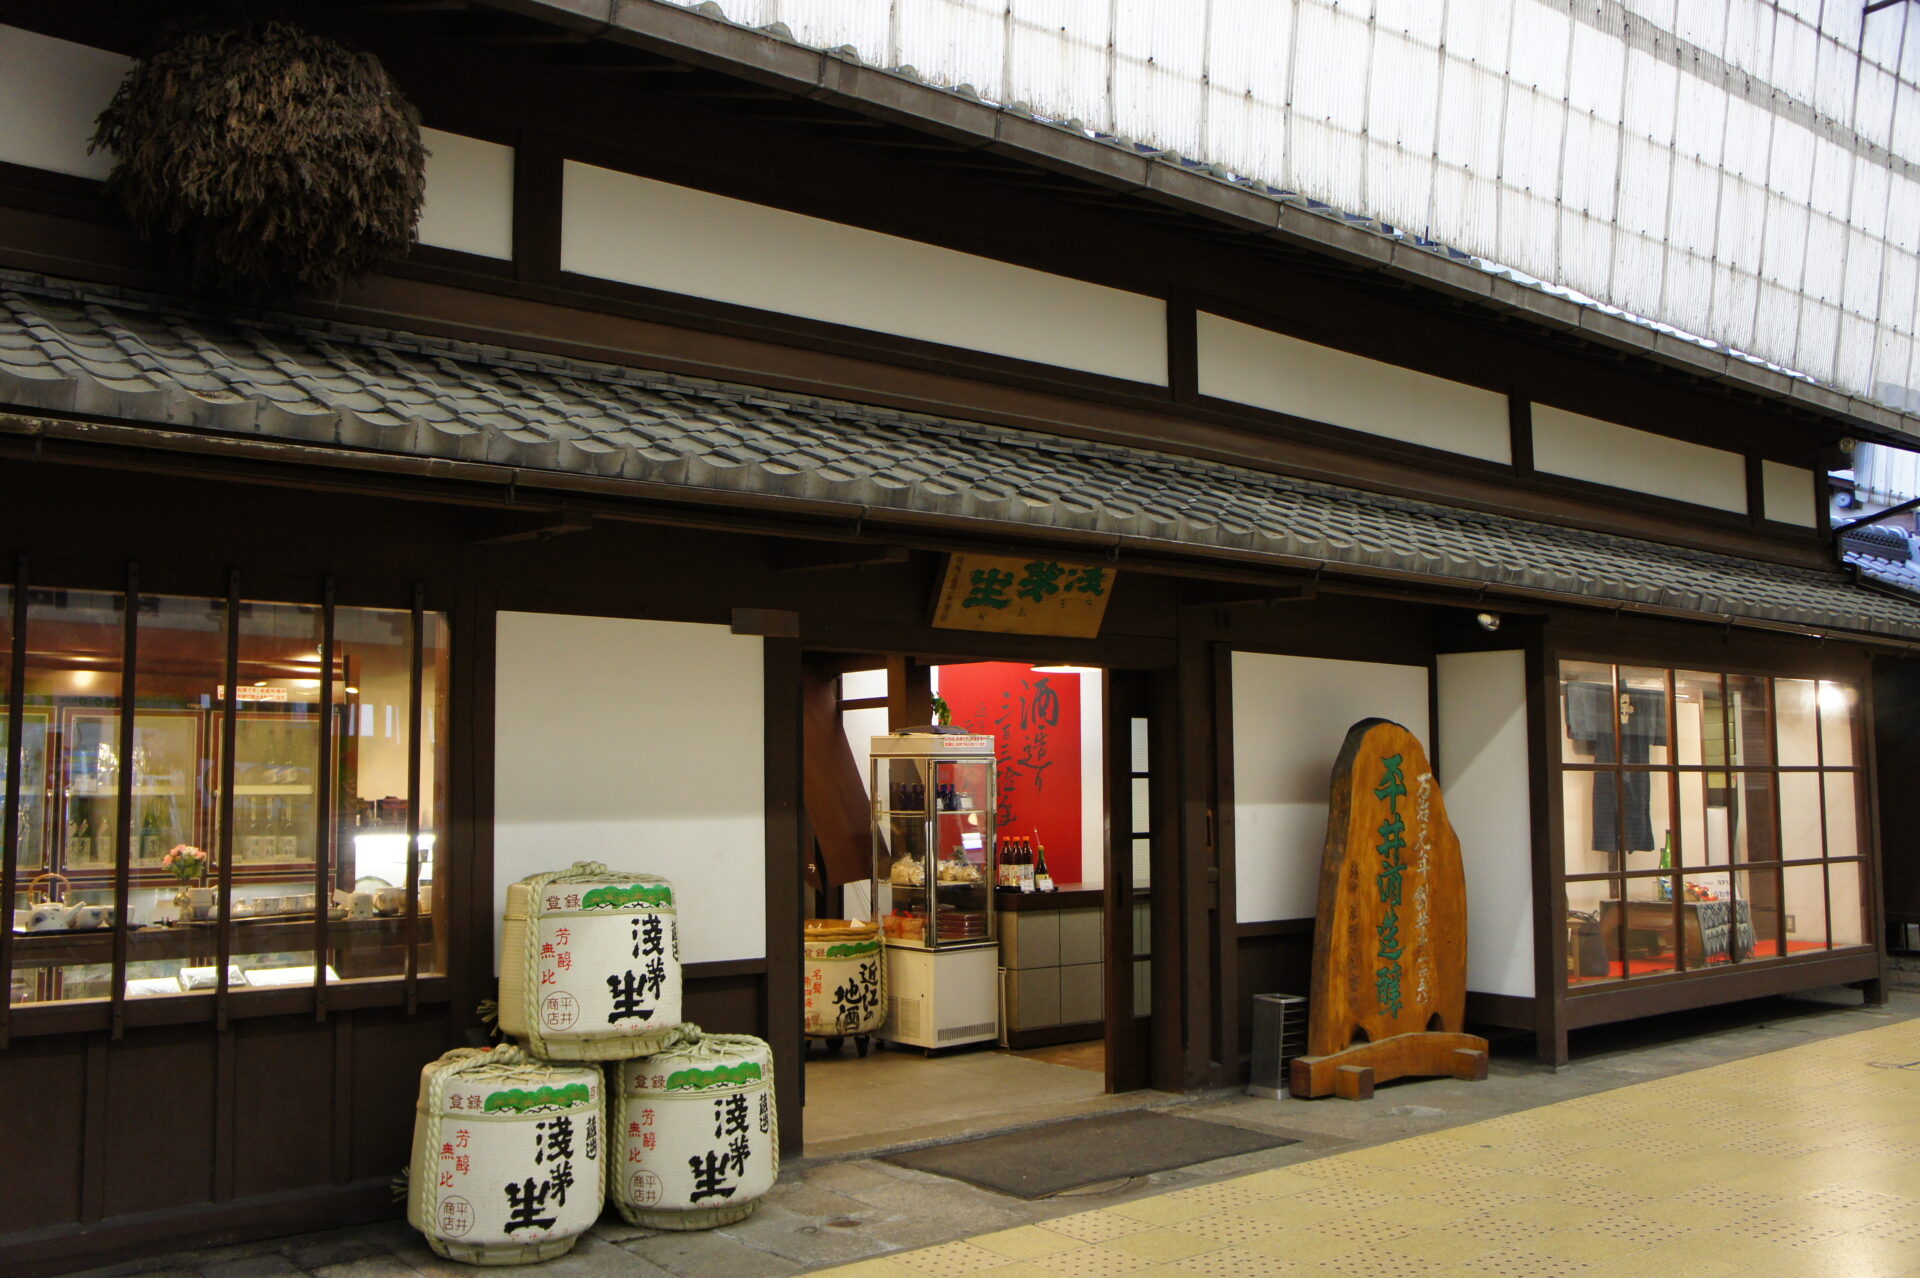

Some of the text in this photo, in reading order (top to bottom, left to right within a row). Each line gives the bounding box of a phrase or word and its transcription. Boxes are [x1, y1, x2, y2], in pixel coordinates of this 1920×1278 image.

[540, 943, 557, 985] 無比
[556, 928, 572, 971] 芳醇
[832, 977, 862, 1033] 地酒
[859, 960, 878, 1021] 近江の
[628, 1121, 642, 1163] 無比
[642, 1108, 656, 1150] 芳醇
[440, 1142, 455, 1188] 無比
[456, 1129, 471, 1175] 芳醇
